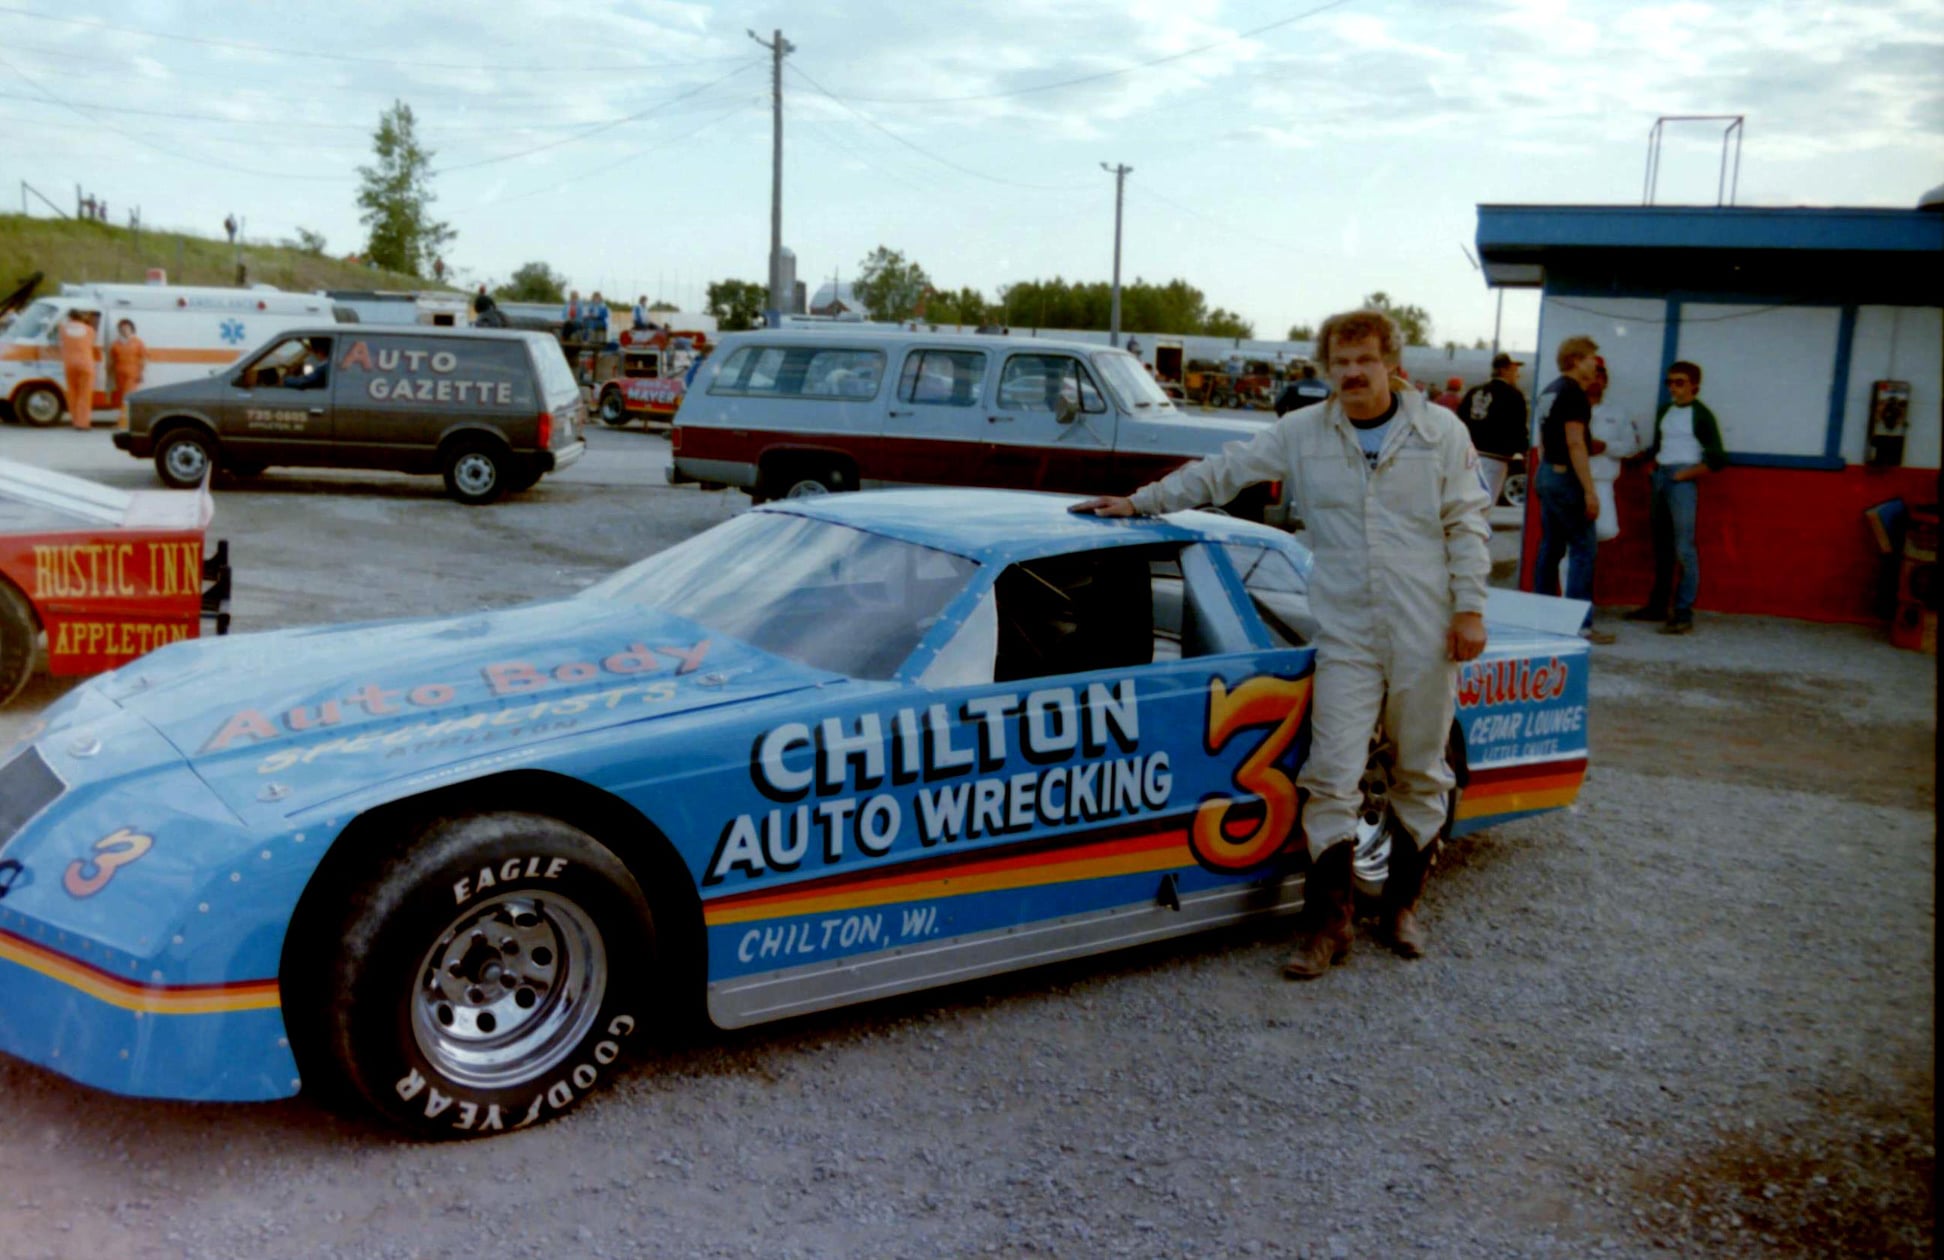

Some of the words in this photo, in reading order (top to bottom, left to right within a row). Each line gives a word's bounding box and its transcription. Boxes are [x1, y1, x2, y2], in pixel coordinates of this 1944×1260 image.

[340, 340, 457, 372] AUTO
[369, 378, 512, 404] GAZETTE
[32, 543, 135, 598] RUSTIC
[147, 542, 201, 595] INN
[200, 683, 455, 753] Auto
[483, 640, 712, 695] Body
[755, 679, 1141, 797] CHILTON
[1469, 711, 1523, 745] CEDAR
[1525, 705, 1584, 738] LOUNGE
[1190, 674, 1315, 873] 3
[709, 792, 901, 881] AUTO
[919, 751, 1173, 841] WRECKING
[63, 826, 155, 900] 3
[453, 856, 568, 905] EAGLE
[738, 913, 890, 963] CHILTON,
